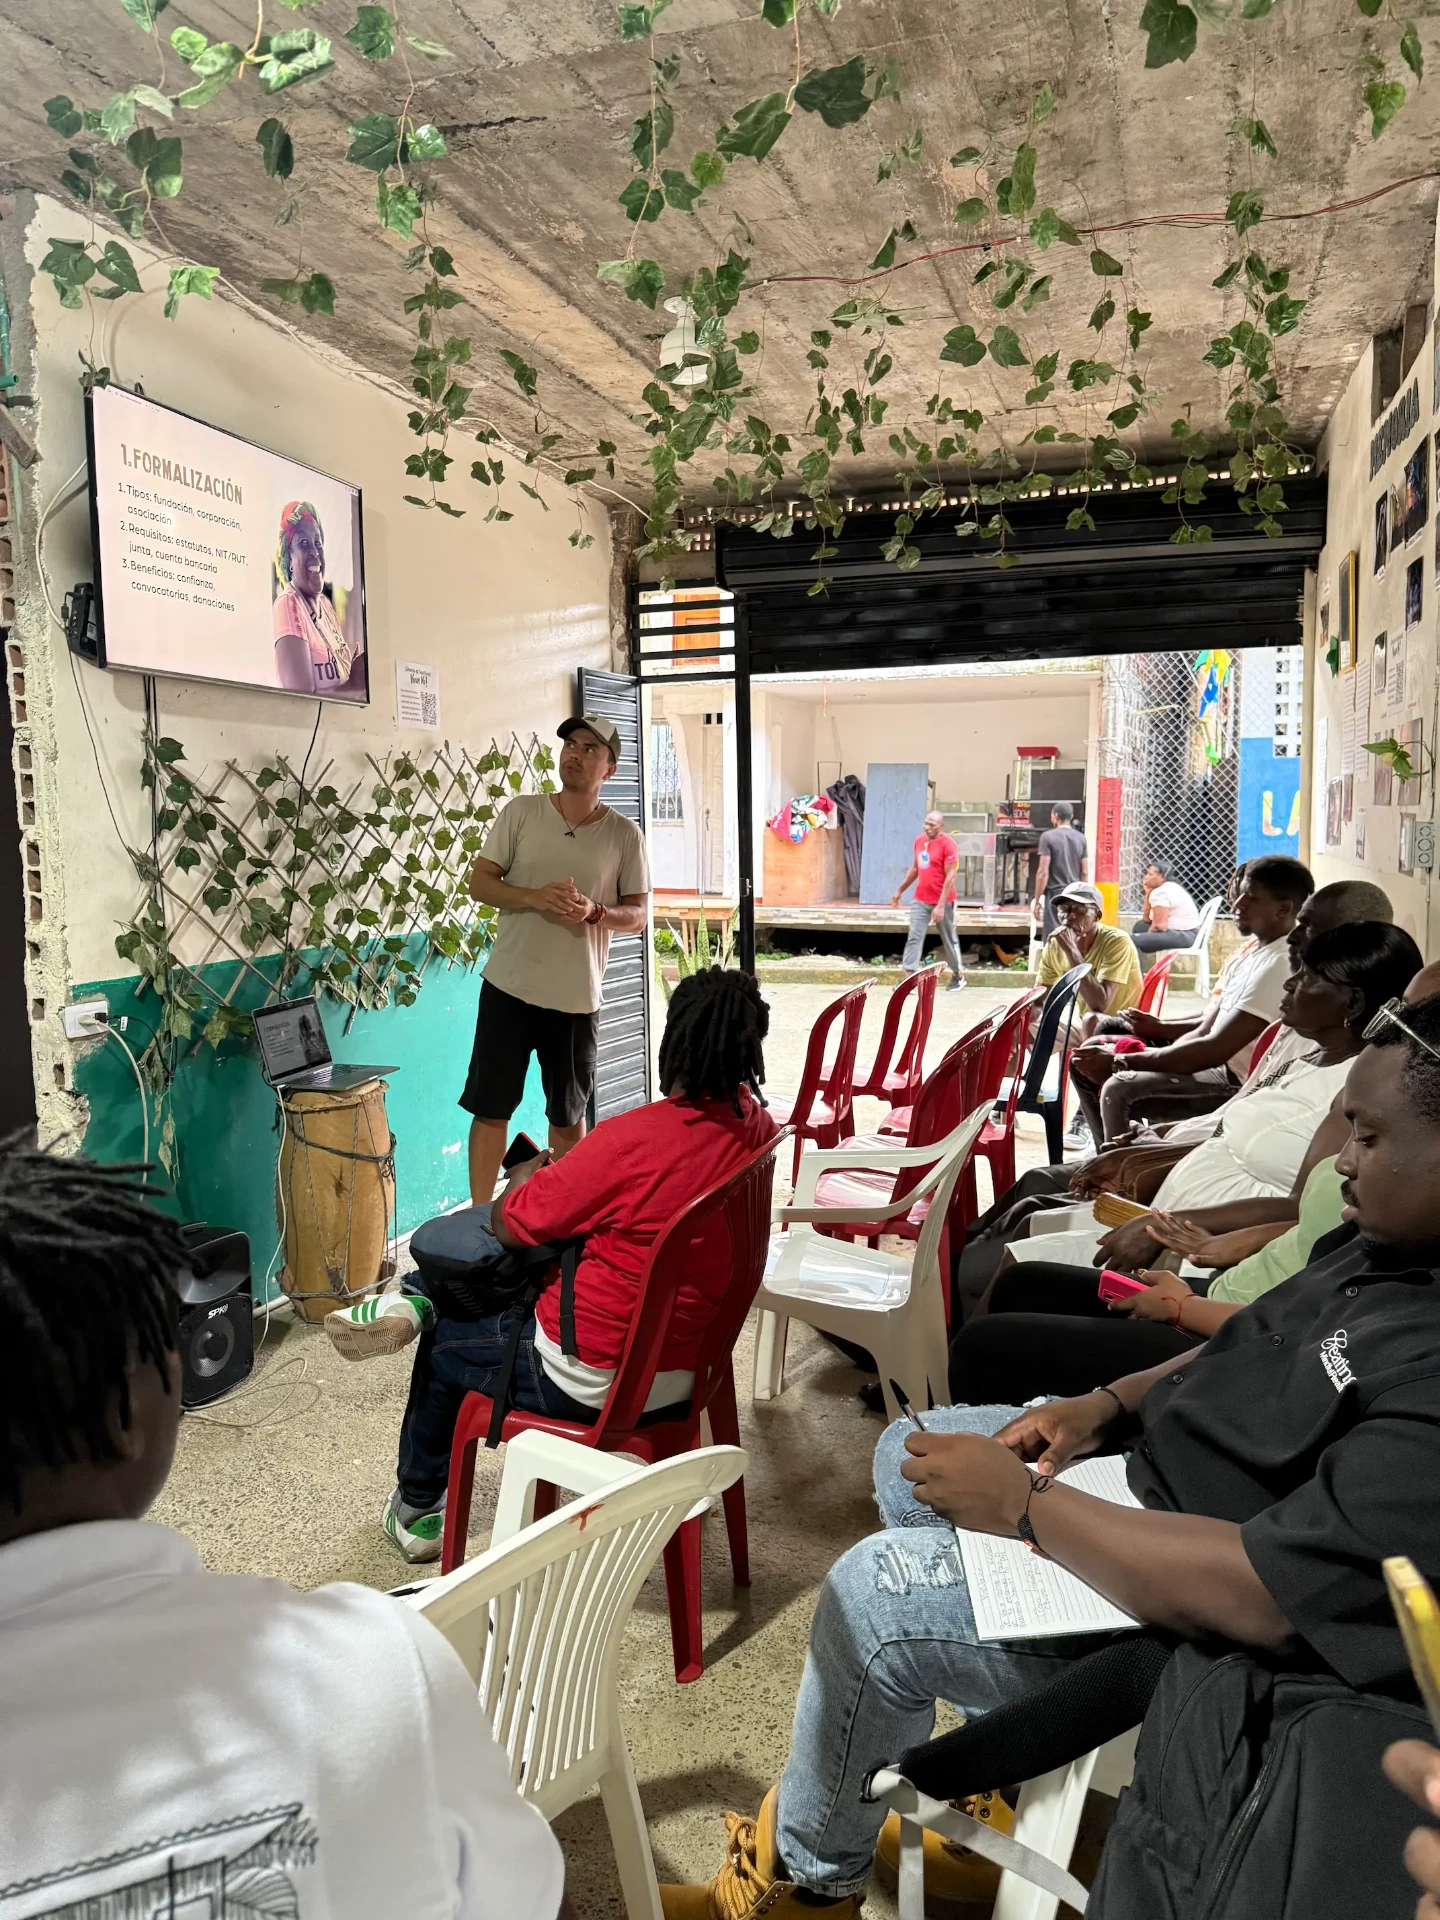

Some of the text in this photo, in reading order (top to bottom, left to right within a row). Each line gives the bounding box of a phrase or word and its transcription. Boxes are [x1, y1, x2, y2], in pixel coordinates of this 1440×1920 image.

[127, 505, 172, 526] asociación
[154, 493, 195, 516] fundación,
[197, 509, 242, 532] corporación,
[129, 540, 218, 574] junta, cuenta bancaria
[175, 538, 214, 558] estatutos,
[215, 548, 249, 567] NIT/RUT,
[131, 580, 235, 612] convocatorias, donaciones
[176, 573, 216, 591] confianza,
